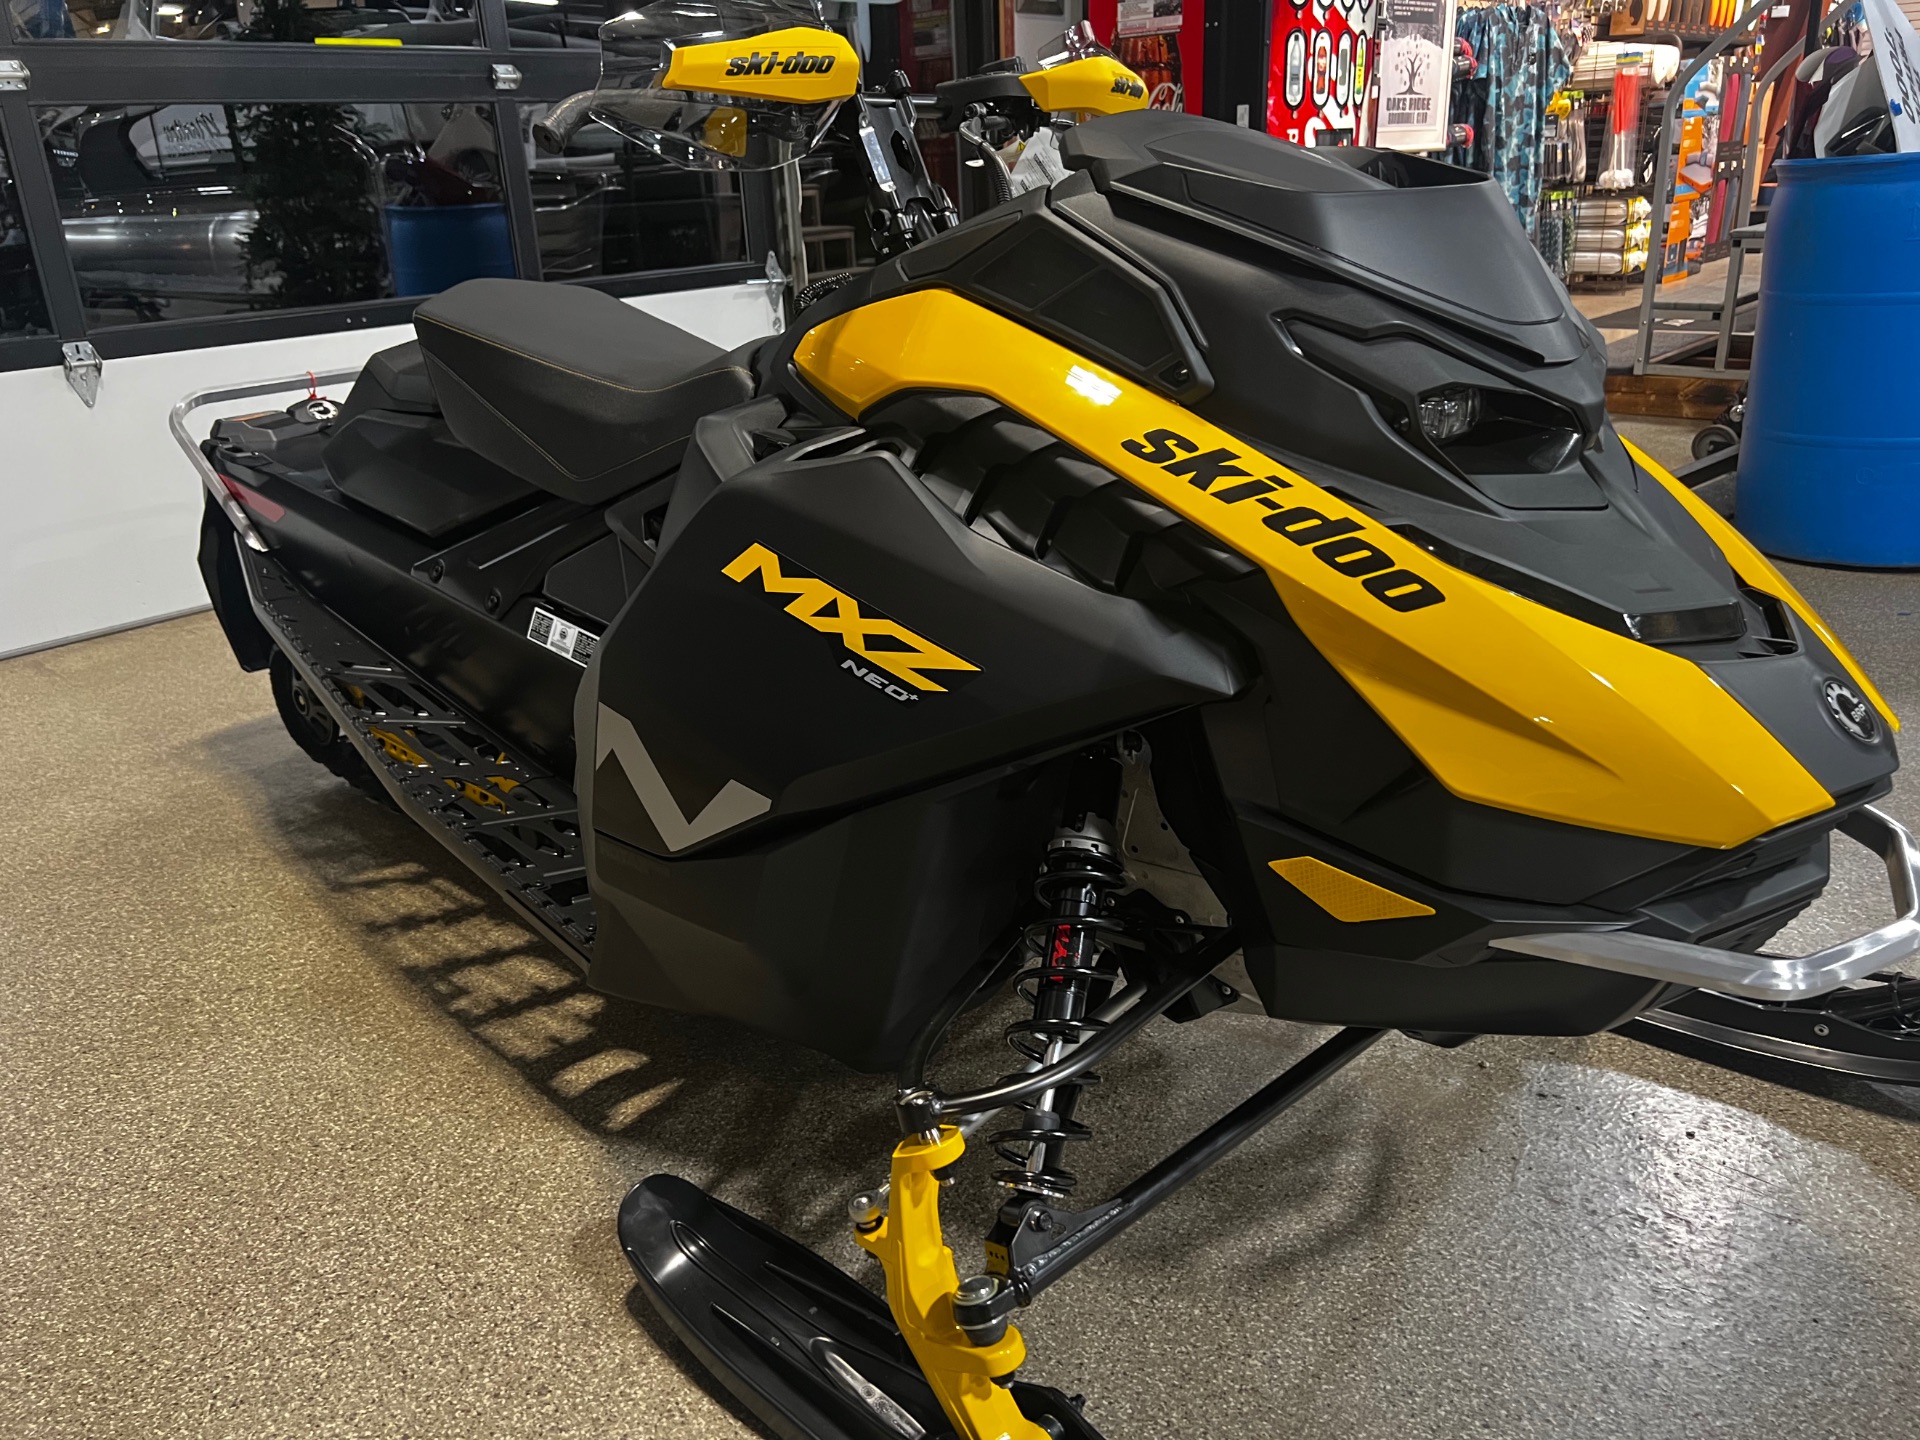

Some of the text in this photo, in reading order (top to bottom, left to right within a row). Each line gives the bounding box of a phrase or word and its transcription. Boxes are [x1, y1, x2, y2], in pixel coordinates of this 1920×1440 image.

[725, 51, 836, 76] ski-doo
[1121, 428, 1446, 613] ski-doo
[721, 542, 981, 692] MXZ
[1851, 704, 1865, 722] BRP
